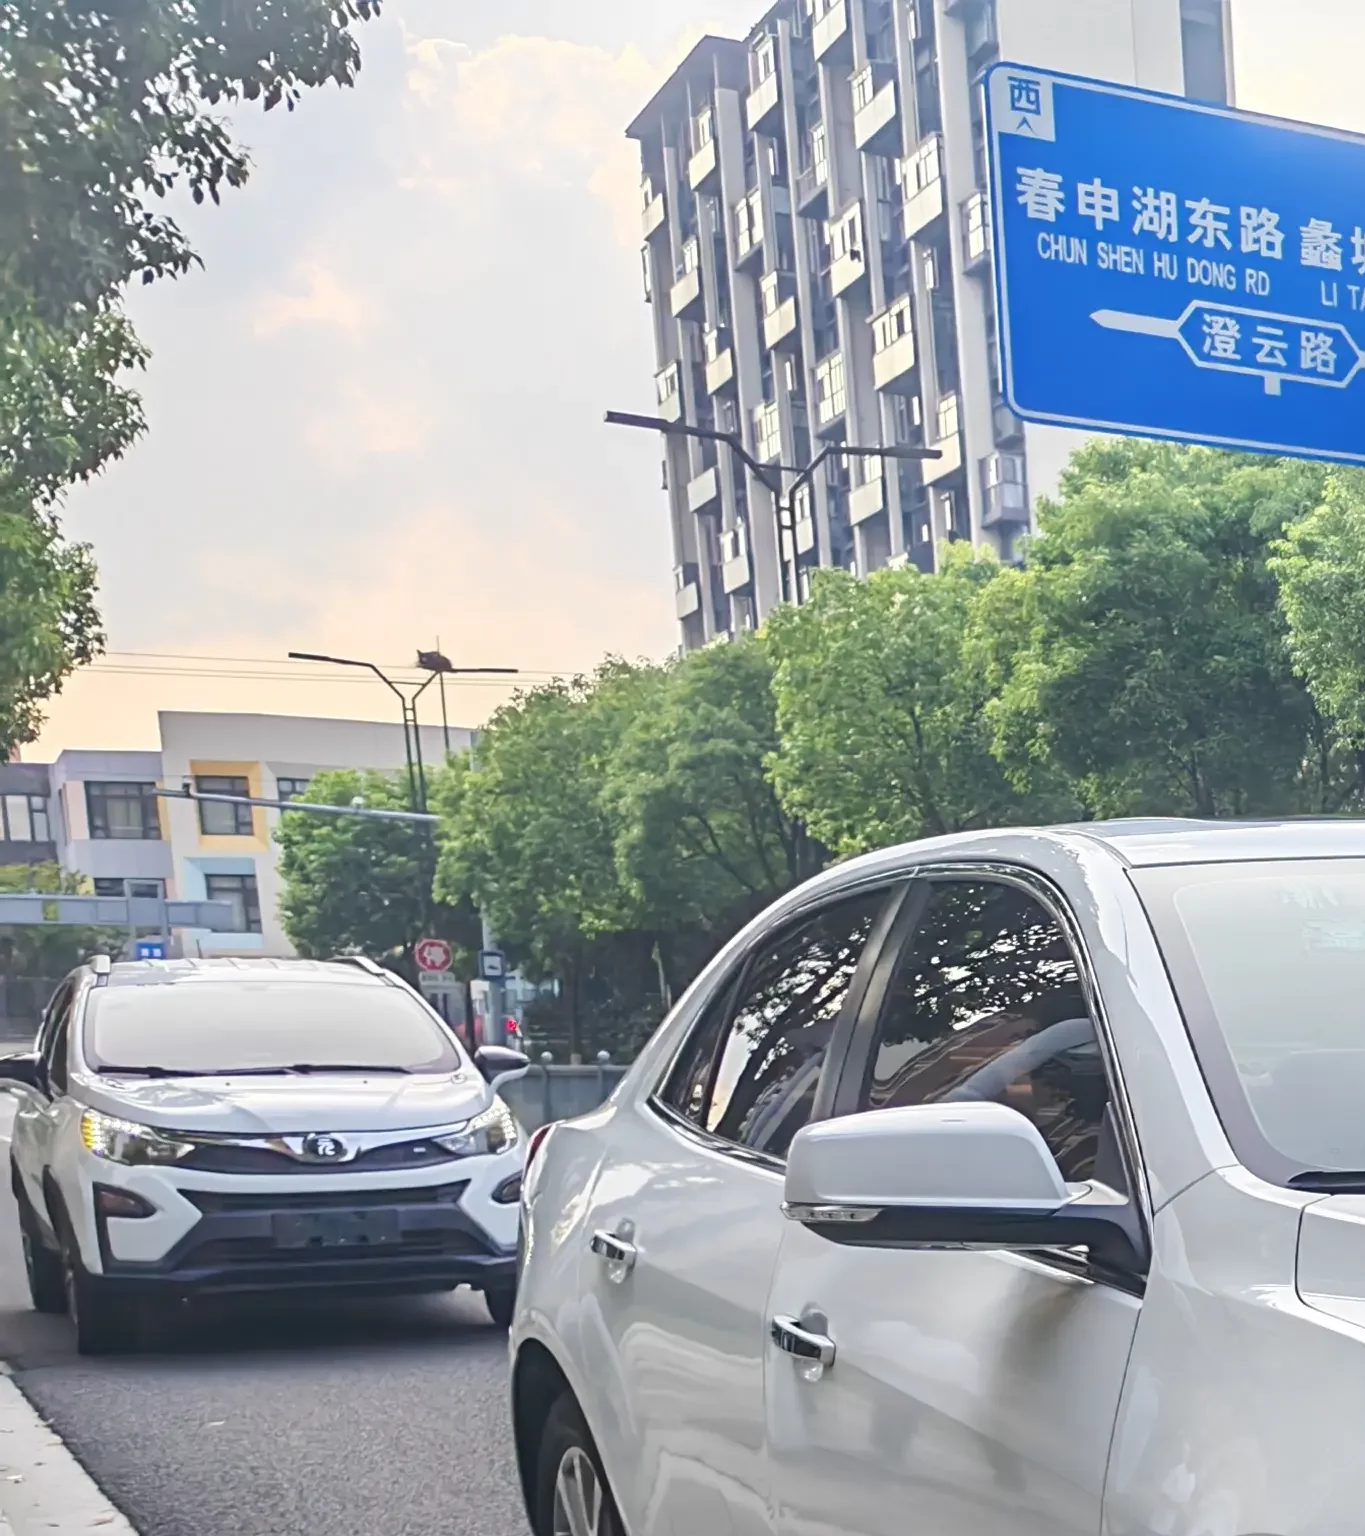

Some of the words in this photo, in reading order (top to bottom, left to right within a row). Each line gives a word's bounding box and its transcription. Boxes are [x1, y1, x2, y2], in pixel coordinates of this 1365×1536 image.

[1007, 76, 1041, 114] 西
[1015, 166, 1285, 260] 春申湖东路
[1037, 232, 1087, 266] CHUN
[1097, 242, 1144, 275] SHEN
[1153, 252, 1177, 281] HU
[1187, 258, 1236, 290] DONG
[1245, 267, 1269, 296] RD
[1320, 280, 1338, 307] LI
[1201, 313, 1337, 375] 澄云路
